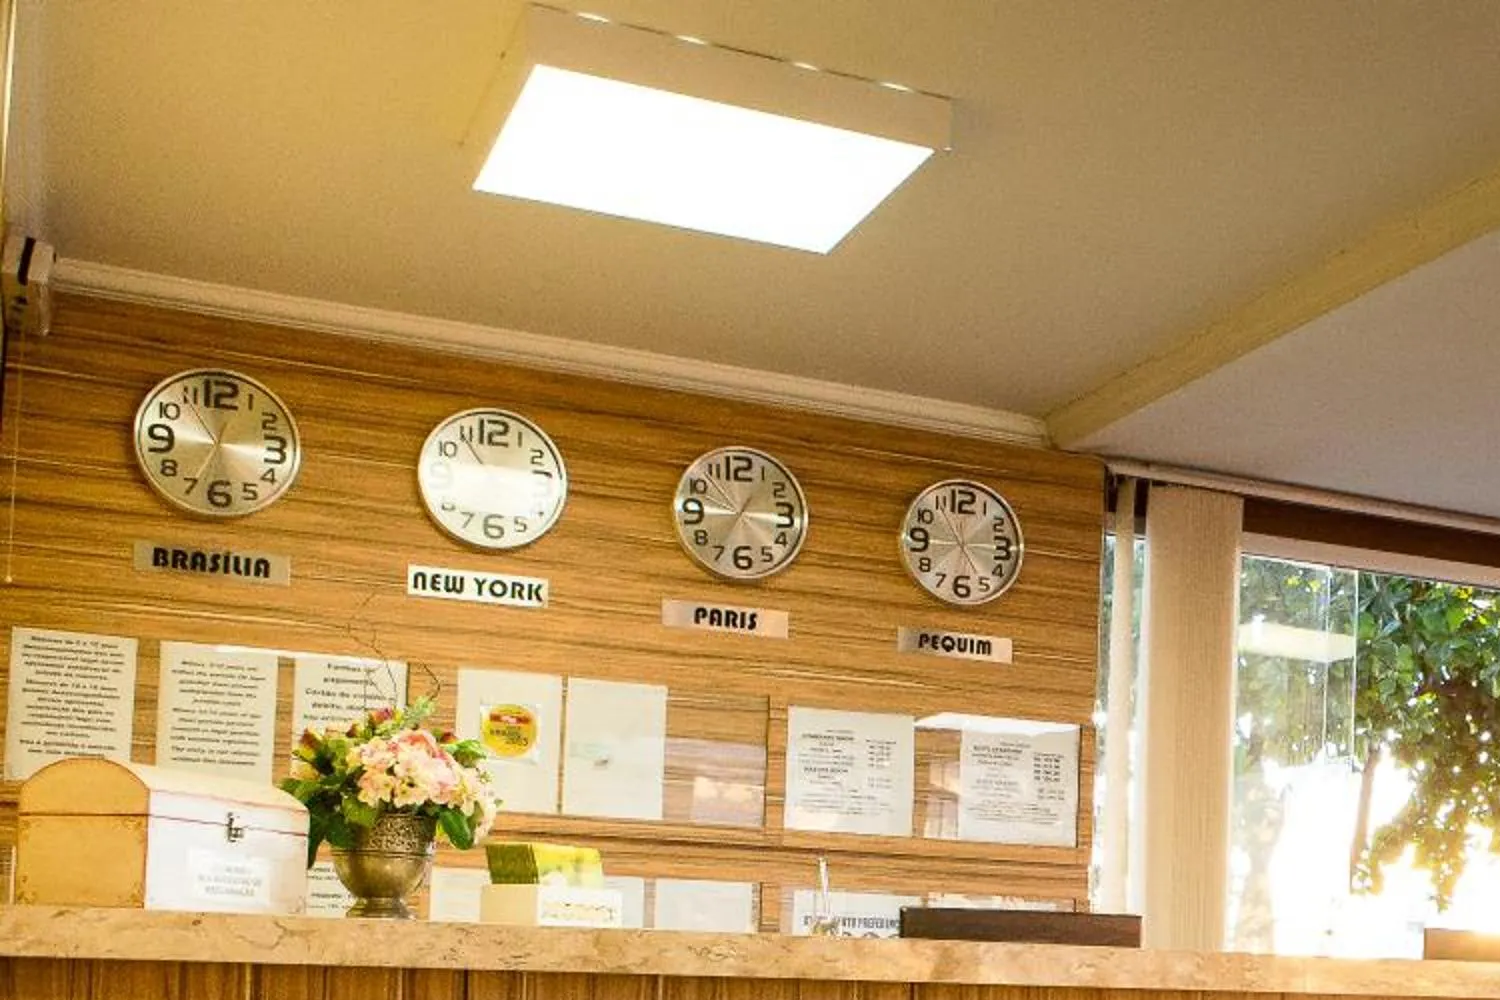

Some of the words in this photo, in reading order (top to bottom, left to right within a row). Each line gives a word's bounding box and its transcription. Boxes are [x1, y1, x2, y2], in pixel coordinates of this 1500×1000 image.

[184, 387, 198, 404] 11
[203, 379, 239, 411] 12
[159, 402, 180, 420] 10
[262, 412, 277, 430] 2
[148, 424, 174, 453] 9
[460, 425, 473, 442] 11
[479, 419, 509, 448] 12
[264, 435, 287, 465] 3
[439, 441, 458, 457] 10
[530, 449, 544, 466] 2
[160, 460, 178, 477] 8
[260, 468, 277, 484] 4
[708, 463, 720, 479] 11
[725, 456, 753, 482] 12
[184, 478, 198, 495] 7
[207, 480, 232, 508] 6
[242, 483, 258, 500] 5
[689, 478, 708, 494] 10
[772, 481, 785, 498] 2
[935, 495, 946, 510] 11
[950, 489, 976, 515] 12
[460, 512, 474, 528] 7
[682, 498, 704, 525] 9
[775, 502, 794, 528] 3
[917, 508, 934, 524] 10
[483, 514, 504, 539] 6
[513, 516, 528, 532] 5
[993, 517, 1004, 533] 2
[694, 530, 708, 546] 8
[775, 532, 788, 547] 4
[909, 527, 929, 553] 9
[712, 545, 725, 560] 7
[761, 546, 773, 562] 5
[993, 536, 1011, 560] 3
[152, 547, 270, 578] BRASÍLIA
[733, 546, 752, 570] 6
[919, 557, 931, 573] 8
[991, 564, 1004, 578] 4
[413, 571, 465, 594] NEW
[473, 577, 543, 602] YORK
[935, 573, 946, 588] 7
[952, 575, 971, 598] 6
[978, 576, 990, 592] 5
[694, 607, 758, 630] PARIS
[918, 633, 992, 656] PEQUIM
